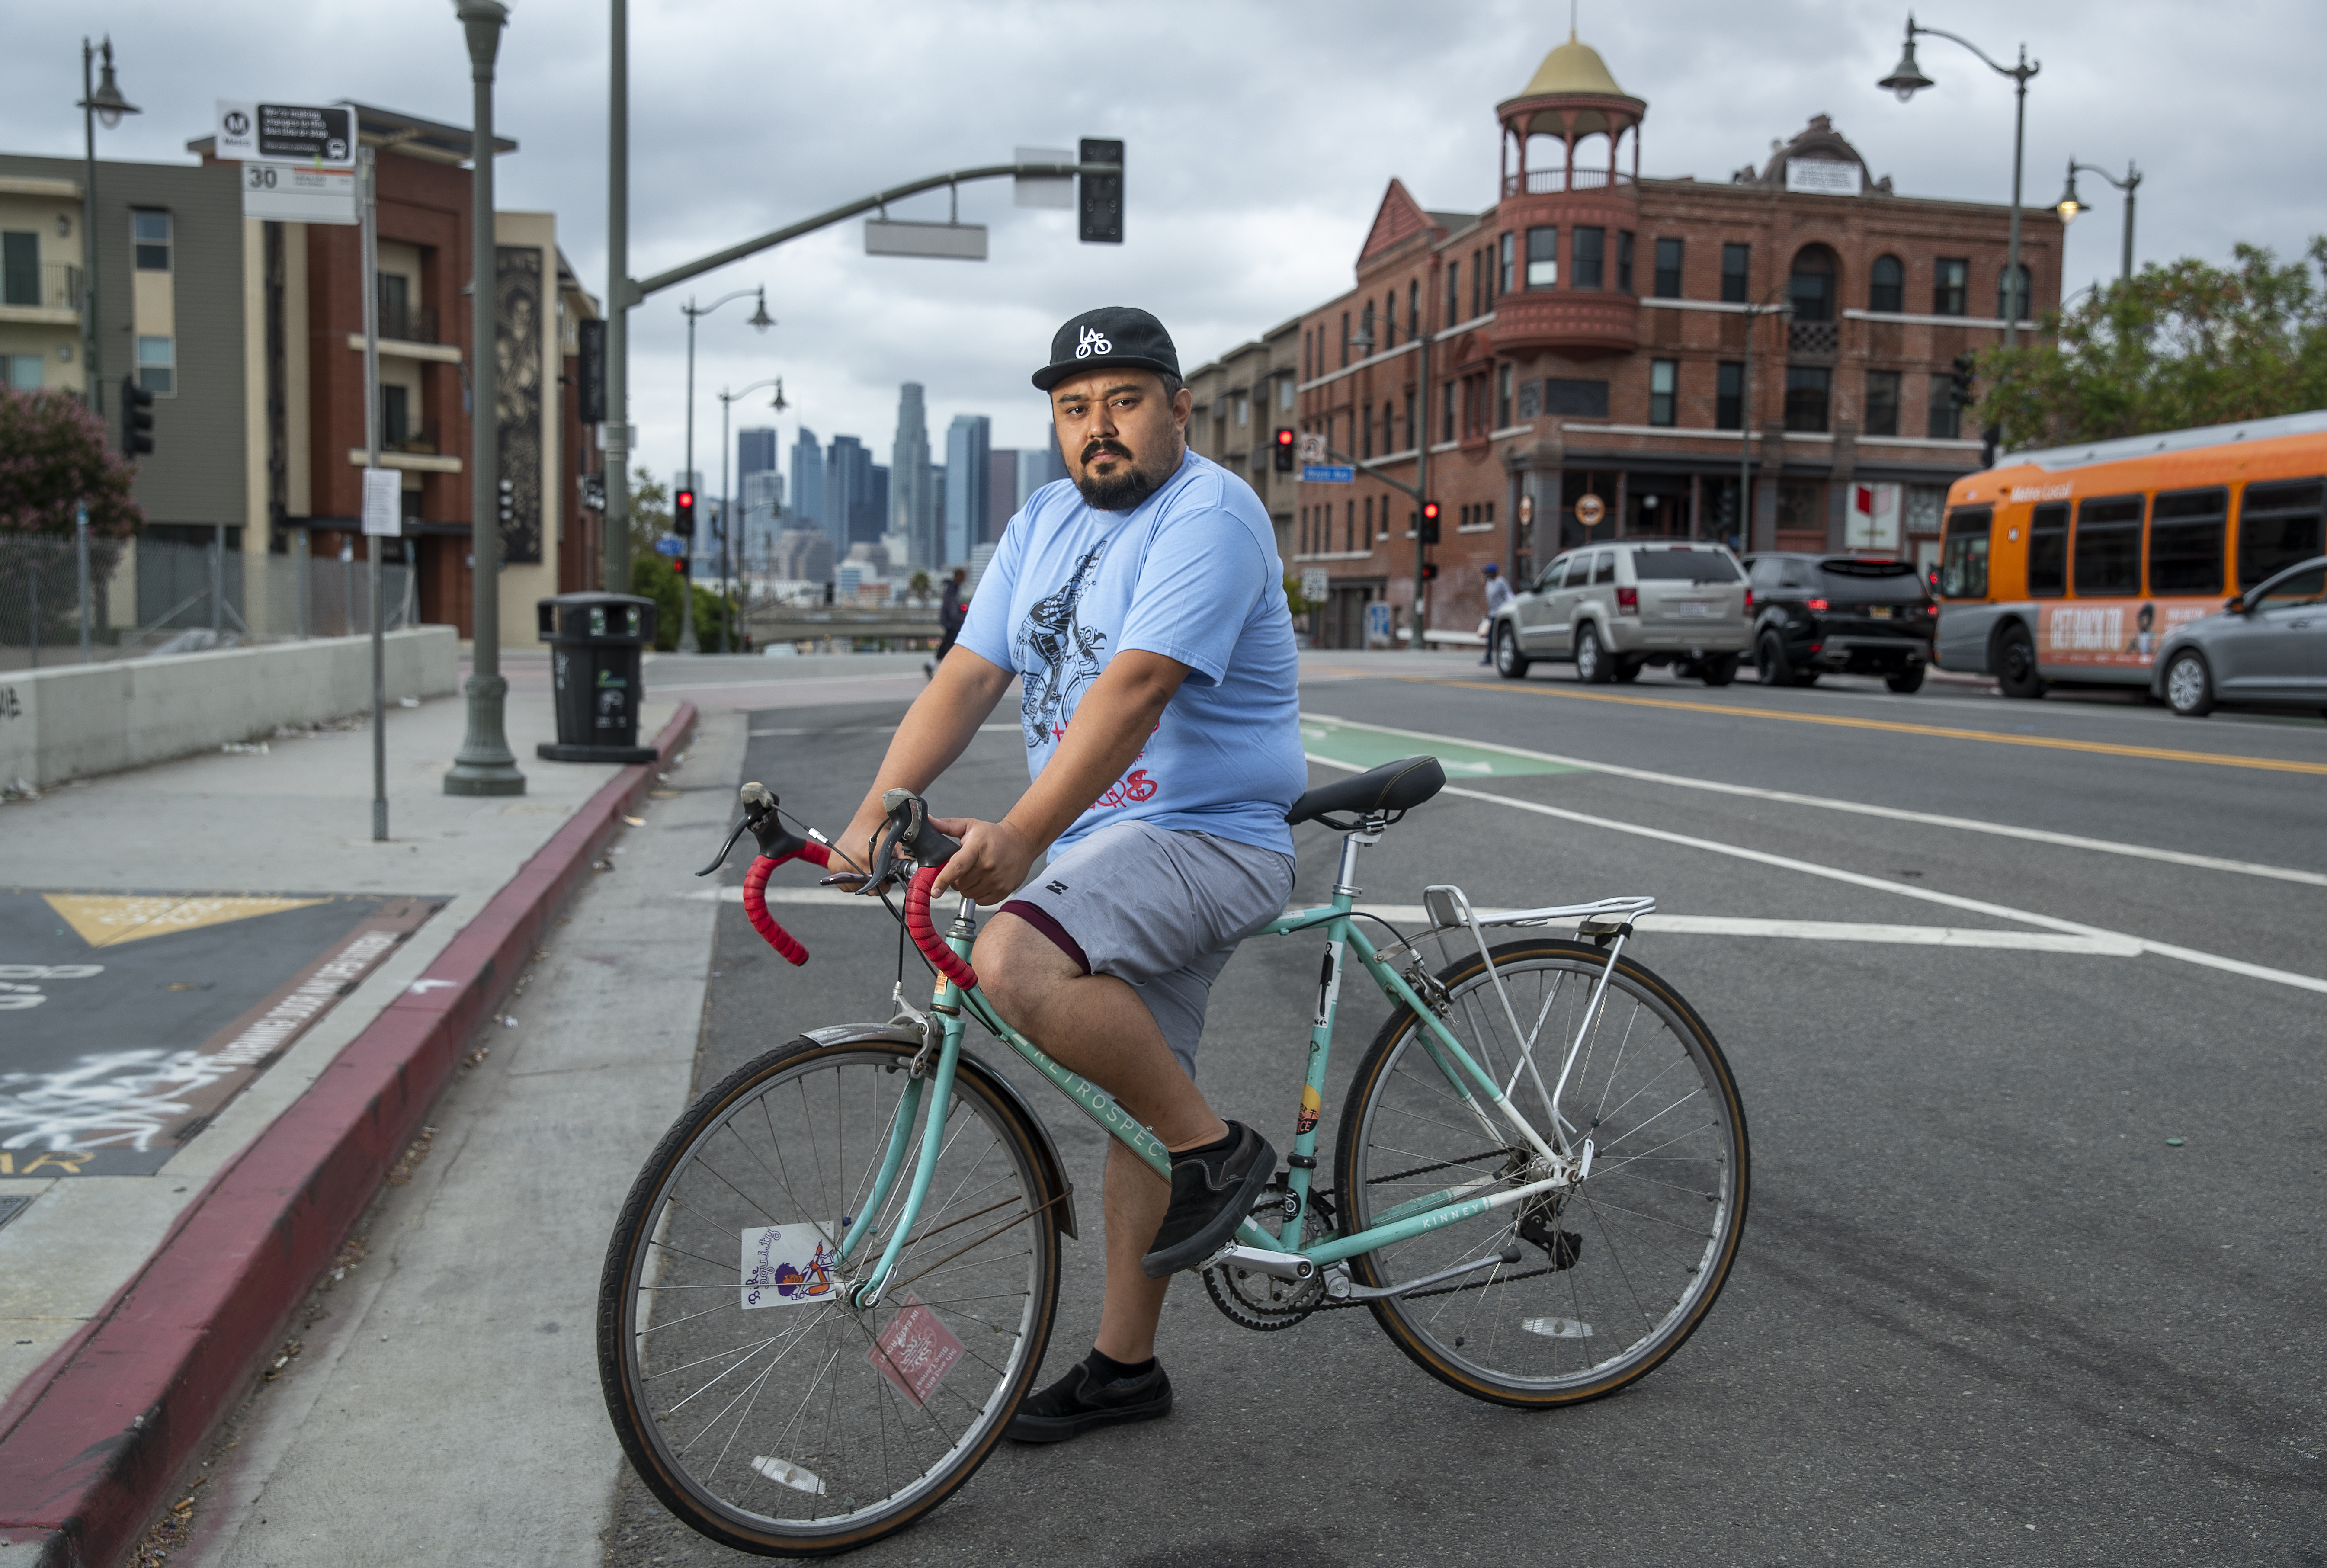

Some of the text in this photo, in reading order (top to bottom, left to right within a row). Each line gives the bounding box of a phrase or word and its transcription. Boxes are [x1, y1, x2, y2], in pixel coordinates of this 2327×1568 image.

[224, 138, 250, 147] Metro
[250, 167, 277, 188] 30
[2010, 480, 2074, 503] Metro Local
[2050, 608, 2073, 649] GET
[1423, 1204, 1478, 1228] KINNEY
[758, 1229, 781, 1289] equity
[746, 1267, 760, 1304] Bike
[909, 1309, 919, 1320] IN
[945, 1347, 958, 1362] 5th
[914, 1345, 949, 1389] Bike Lanes!
[934, 1360, 948, 1377] and
[924, 1376, 937, 1390] 6th
